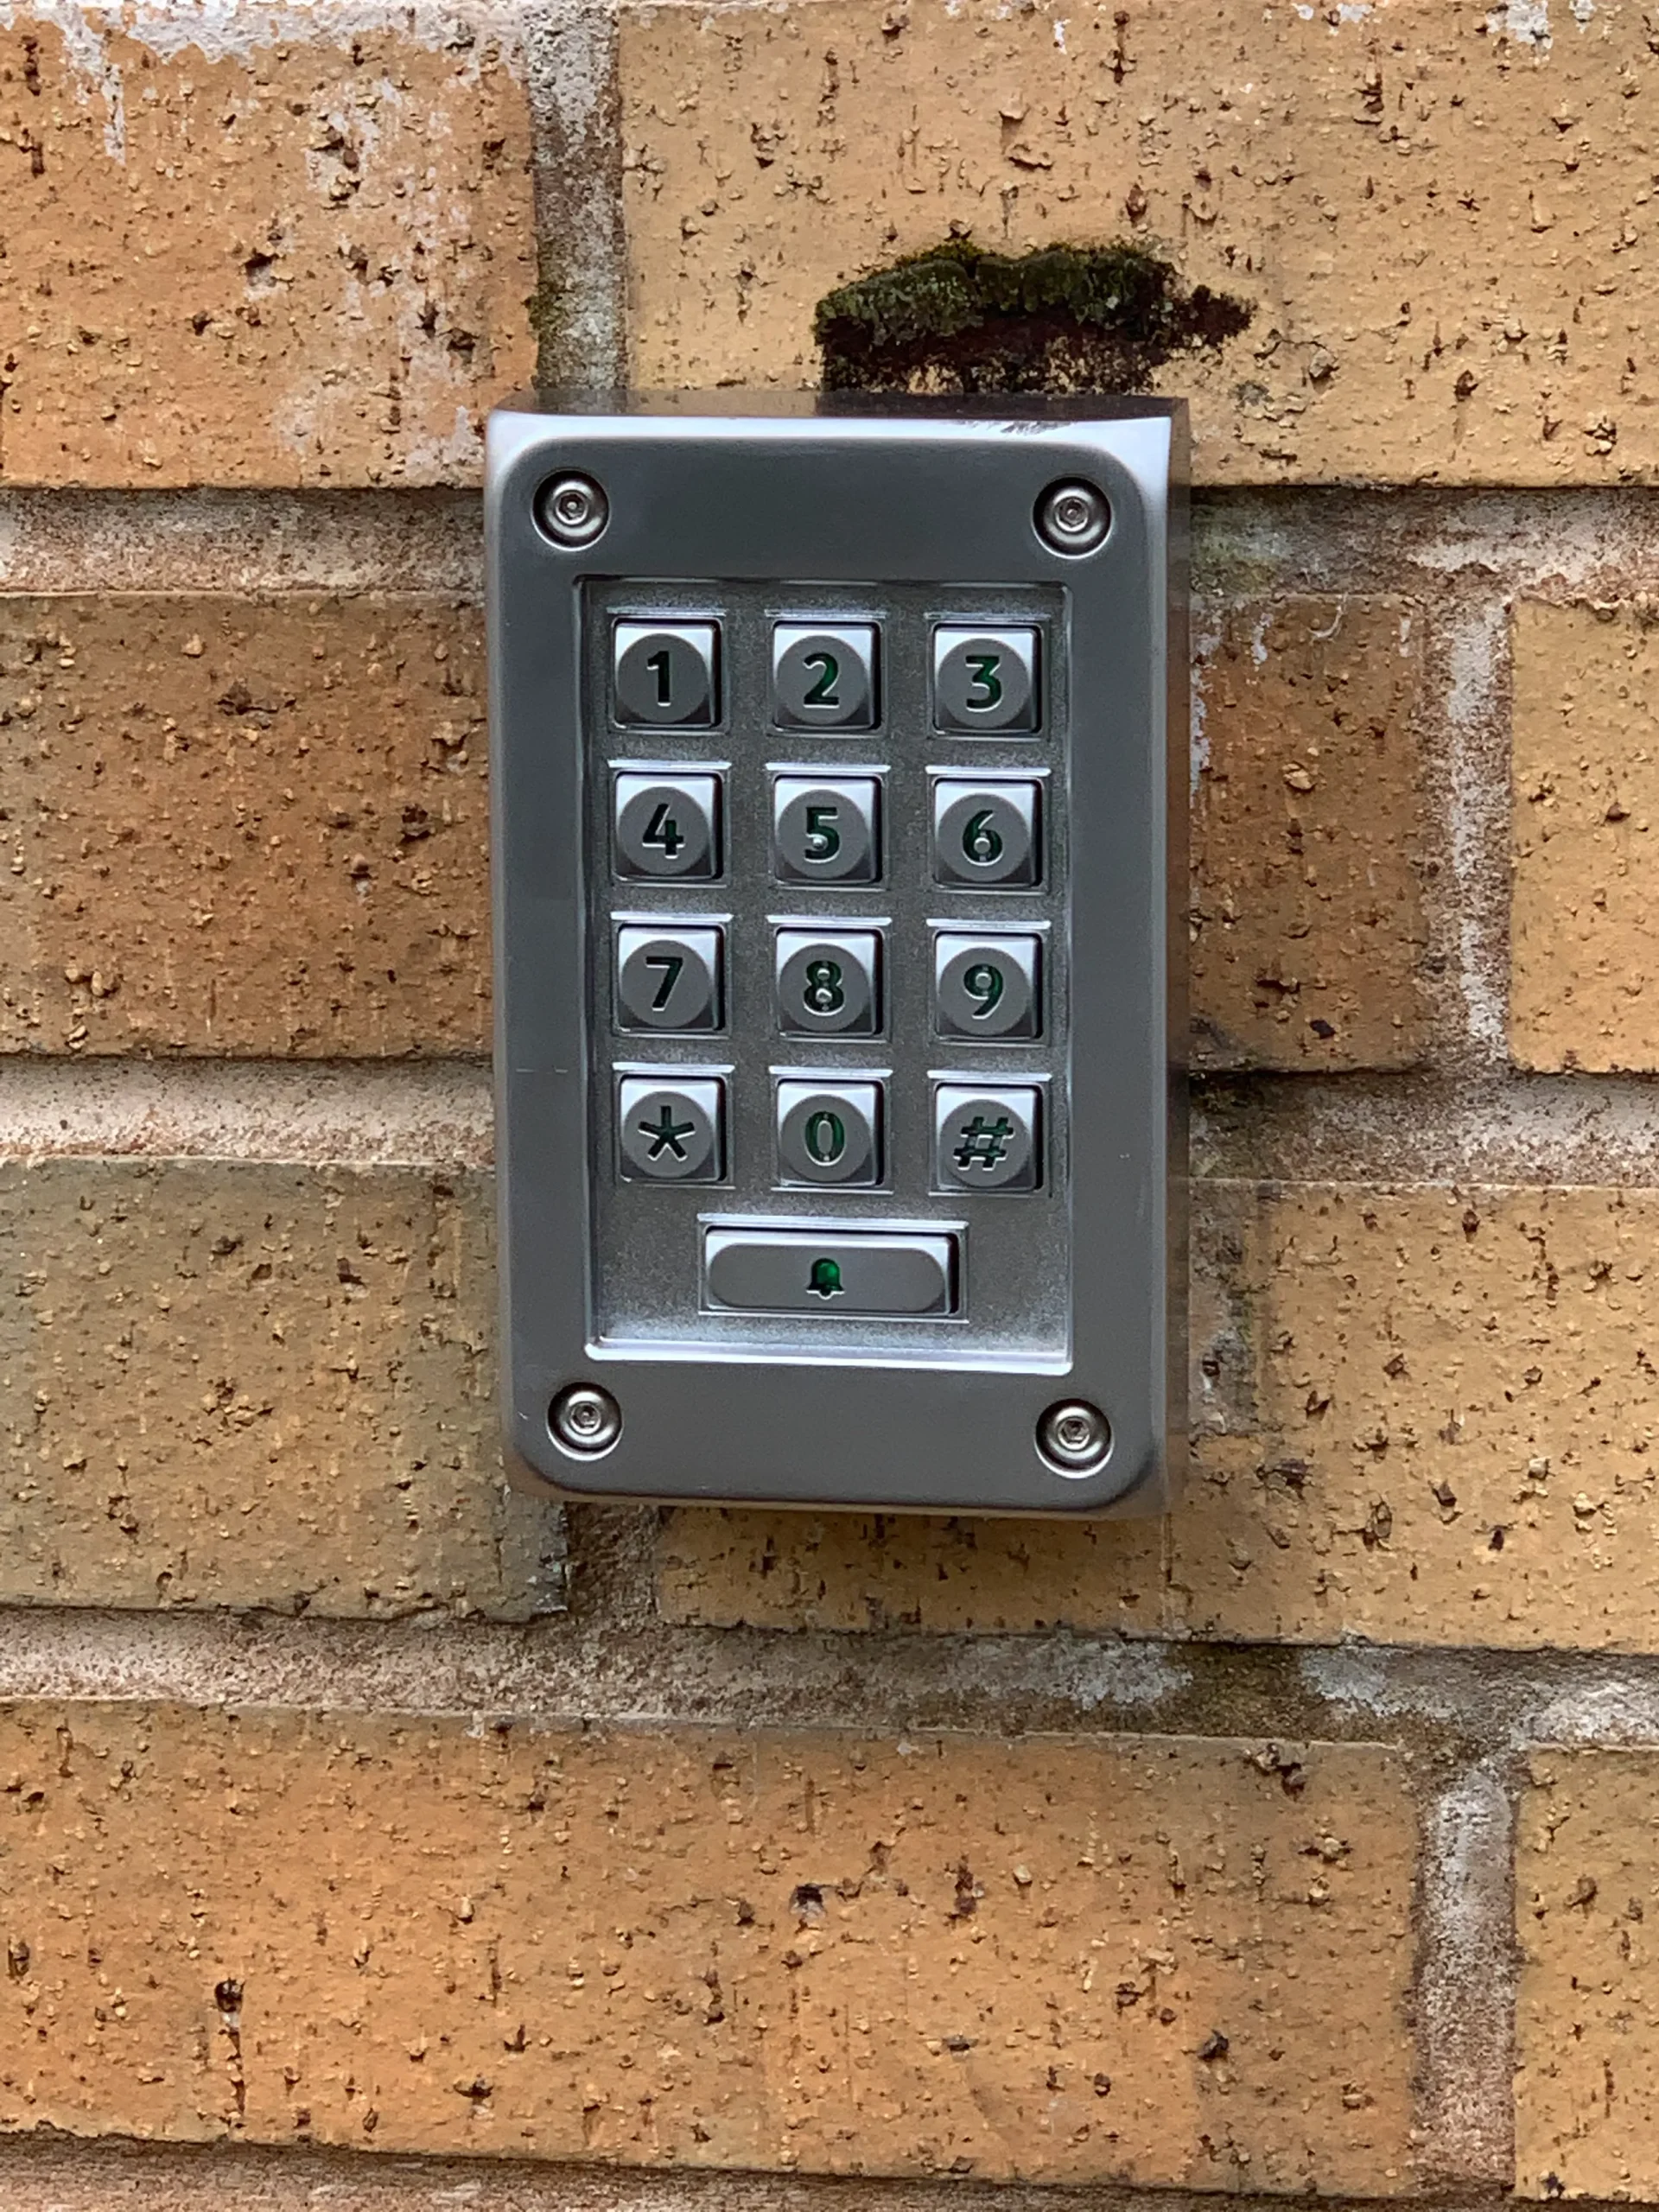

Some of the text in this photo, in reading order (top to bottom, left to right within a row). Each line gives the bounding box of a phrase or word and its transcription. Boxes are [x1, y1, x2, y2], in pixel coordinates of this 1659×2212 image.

[647, 651, 1002, 711] 1 2 3
[642, 804, 1003, 867] 4 5 6
[645, 956, 1003, 1020] 7 8 9
[804, 1110, 846, 1166] 0
[953, 1116, 1014, 1171] #
